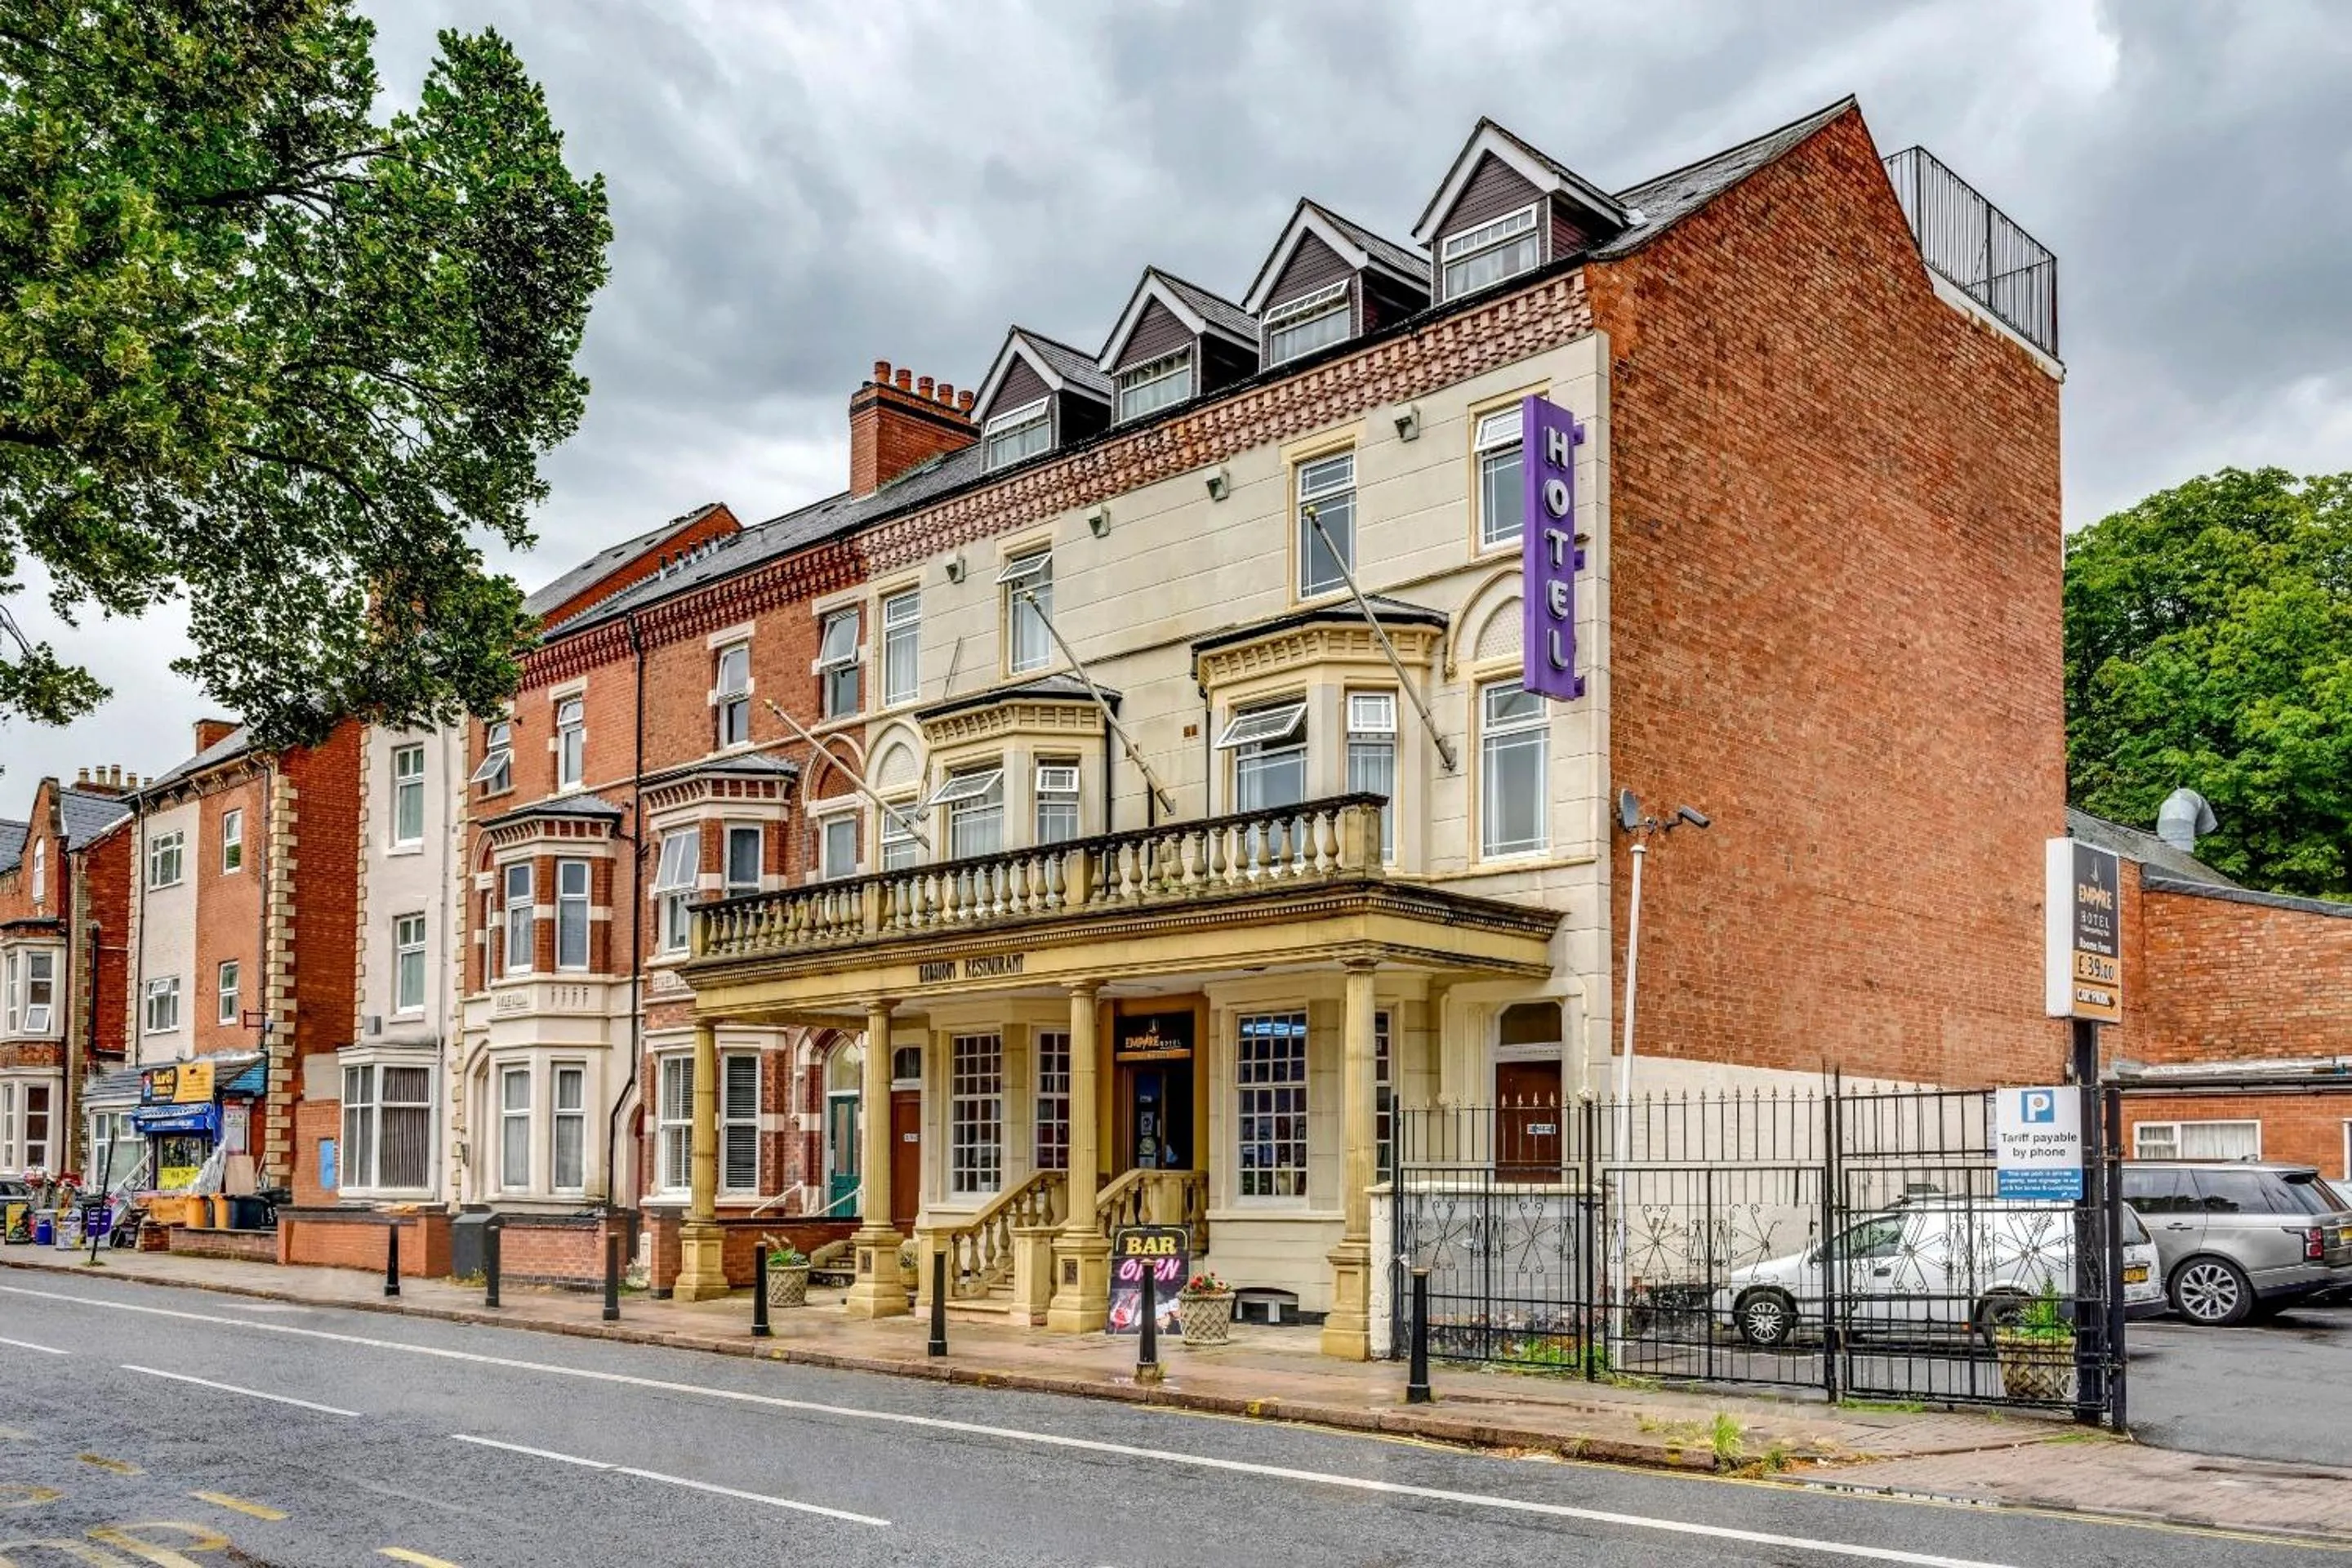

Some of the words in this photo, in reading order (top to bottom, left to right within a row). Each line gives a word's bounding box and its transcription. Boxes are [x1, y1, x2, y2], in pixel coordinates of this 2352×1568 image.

[1543, 425, 1570, 671] HOTEL
[2080, 910, 2110, 929] HOTEL
[2026, 1094, 2051, 1122] P
[2000, 1132, 2029, 1143] Tariff
[2033, 1132, 2078, 1144] payable
[2013, 1147, 2027, 1159] by
[2030, 1147, 2066, 1159] phone
[1125, 1236, 1177, 1255] BAR
